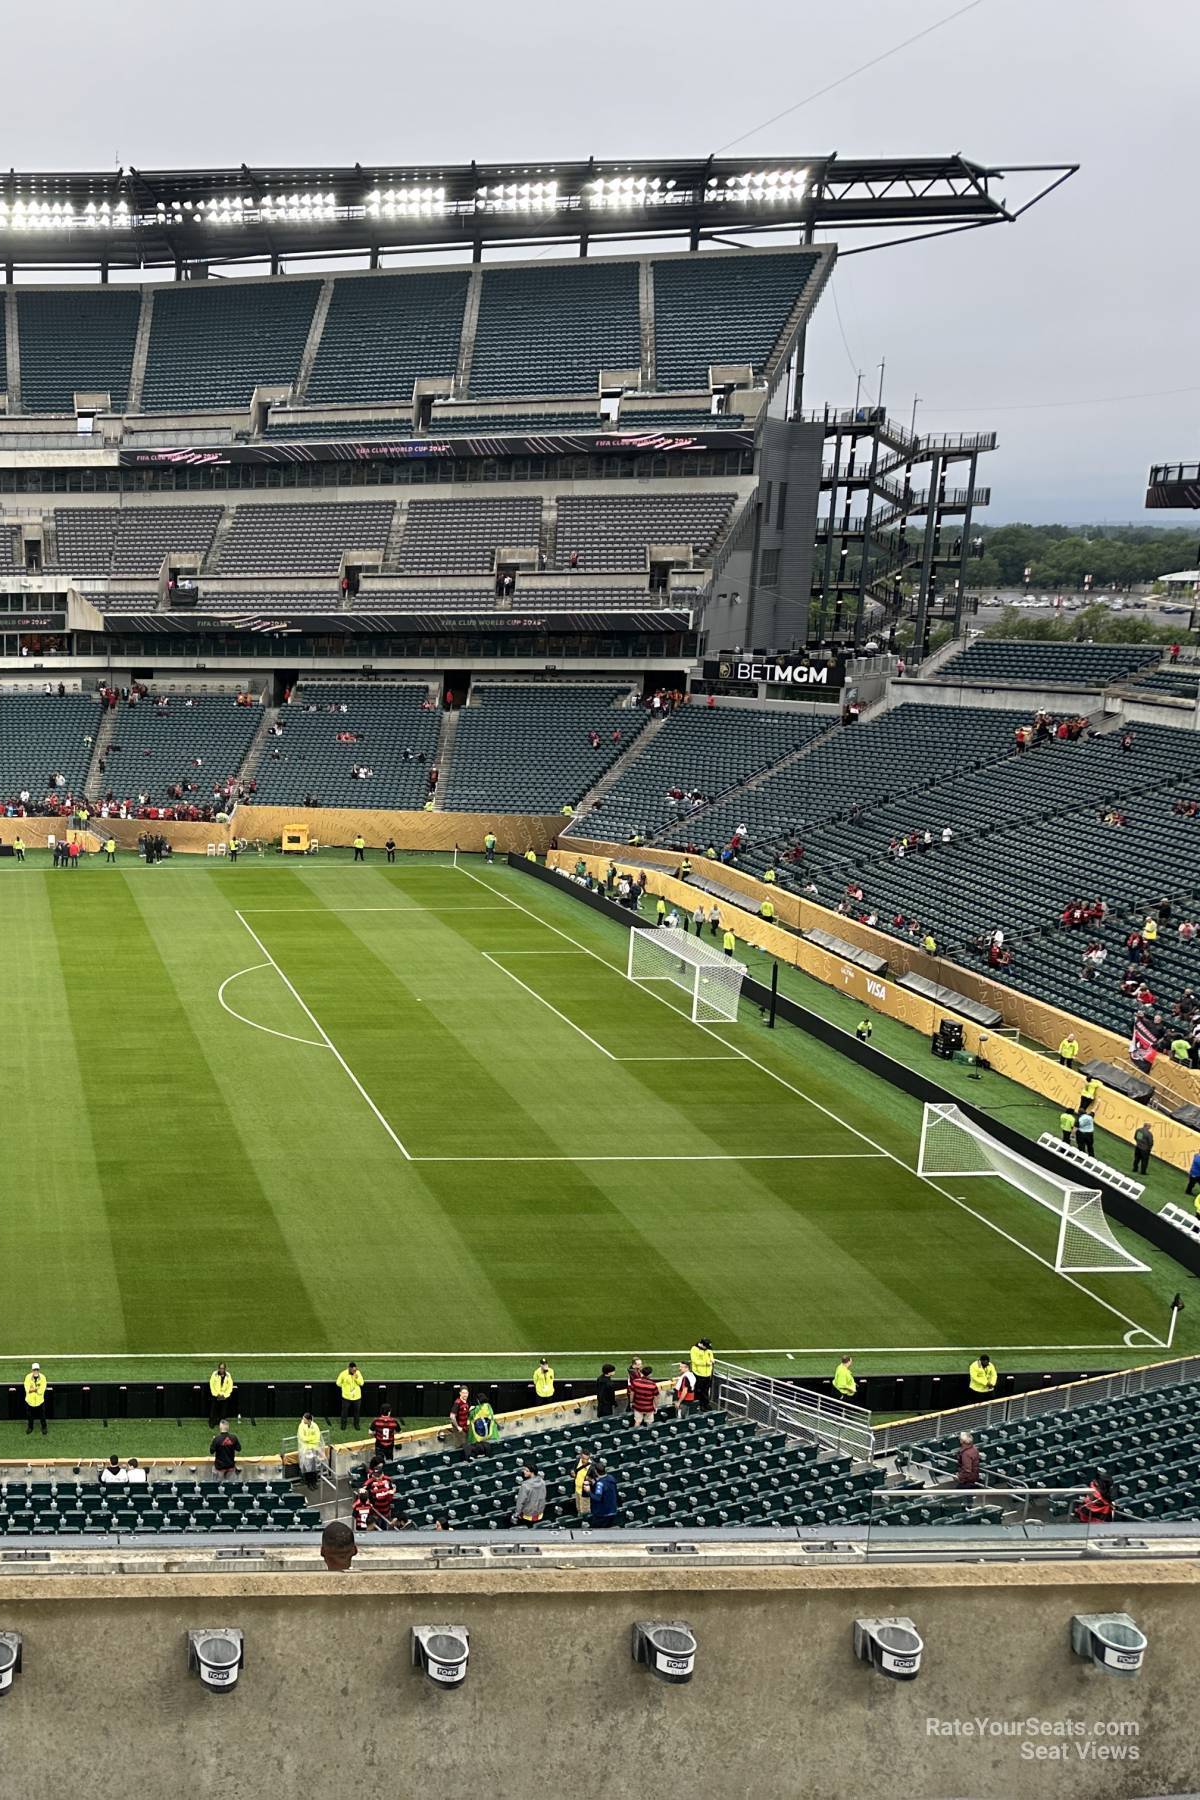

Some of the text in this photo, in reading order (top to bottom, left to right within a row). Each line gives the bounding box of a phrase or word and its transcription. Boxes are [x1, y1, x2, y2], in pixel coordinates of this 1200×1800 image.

[737, 662, 828, 684] BETMGM
[865, 977, 886, 1001] VISA
[667, 1660, 688, 1668] TORK
[894, 1659, 916, 1667] TORK
[208, 1671, 229, 1679] TORK
[437, 1668, 459, 1676] TORK
